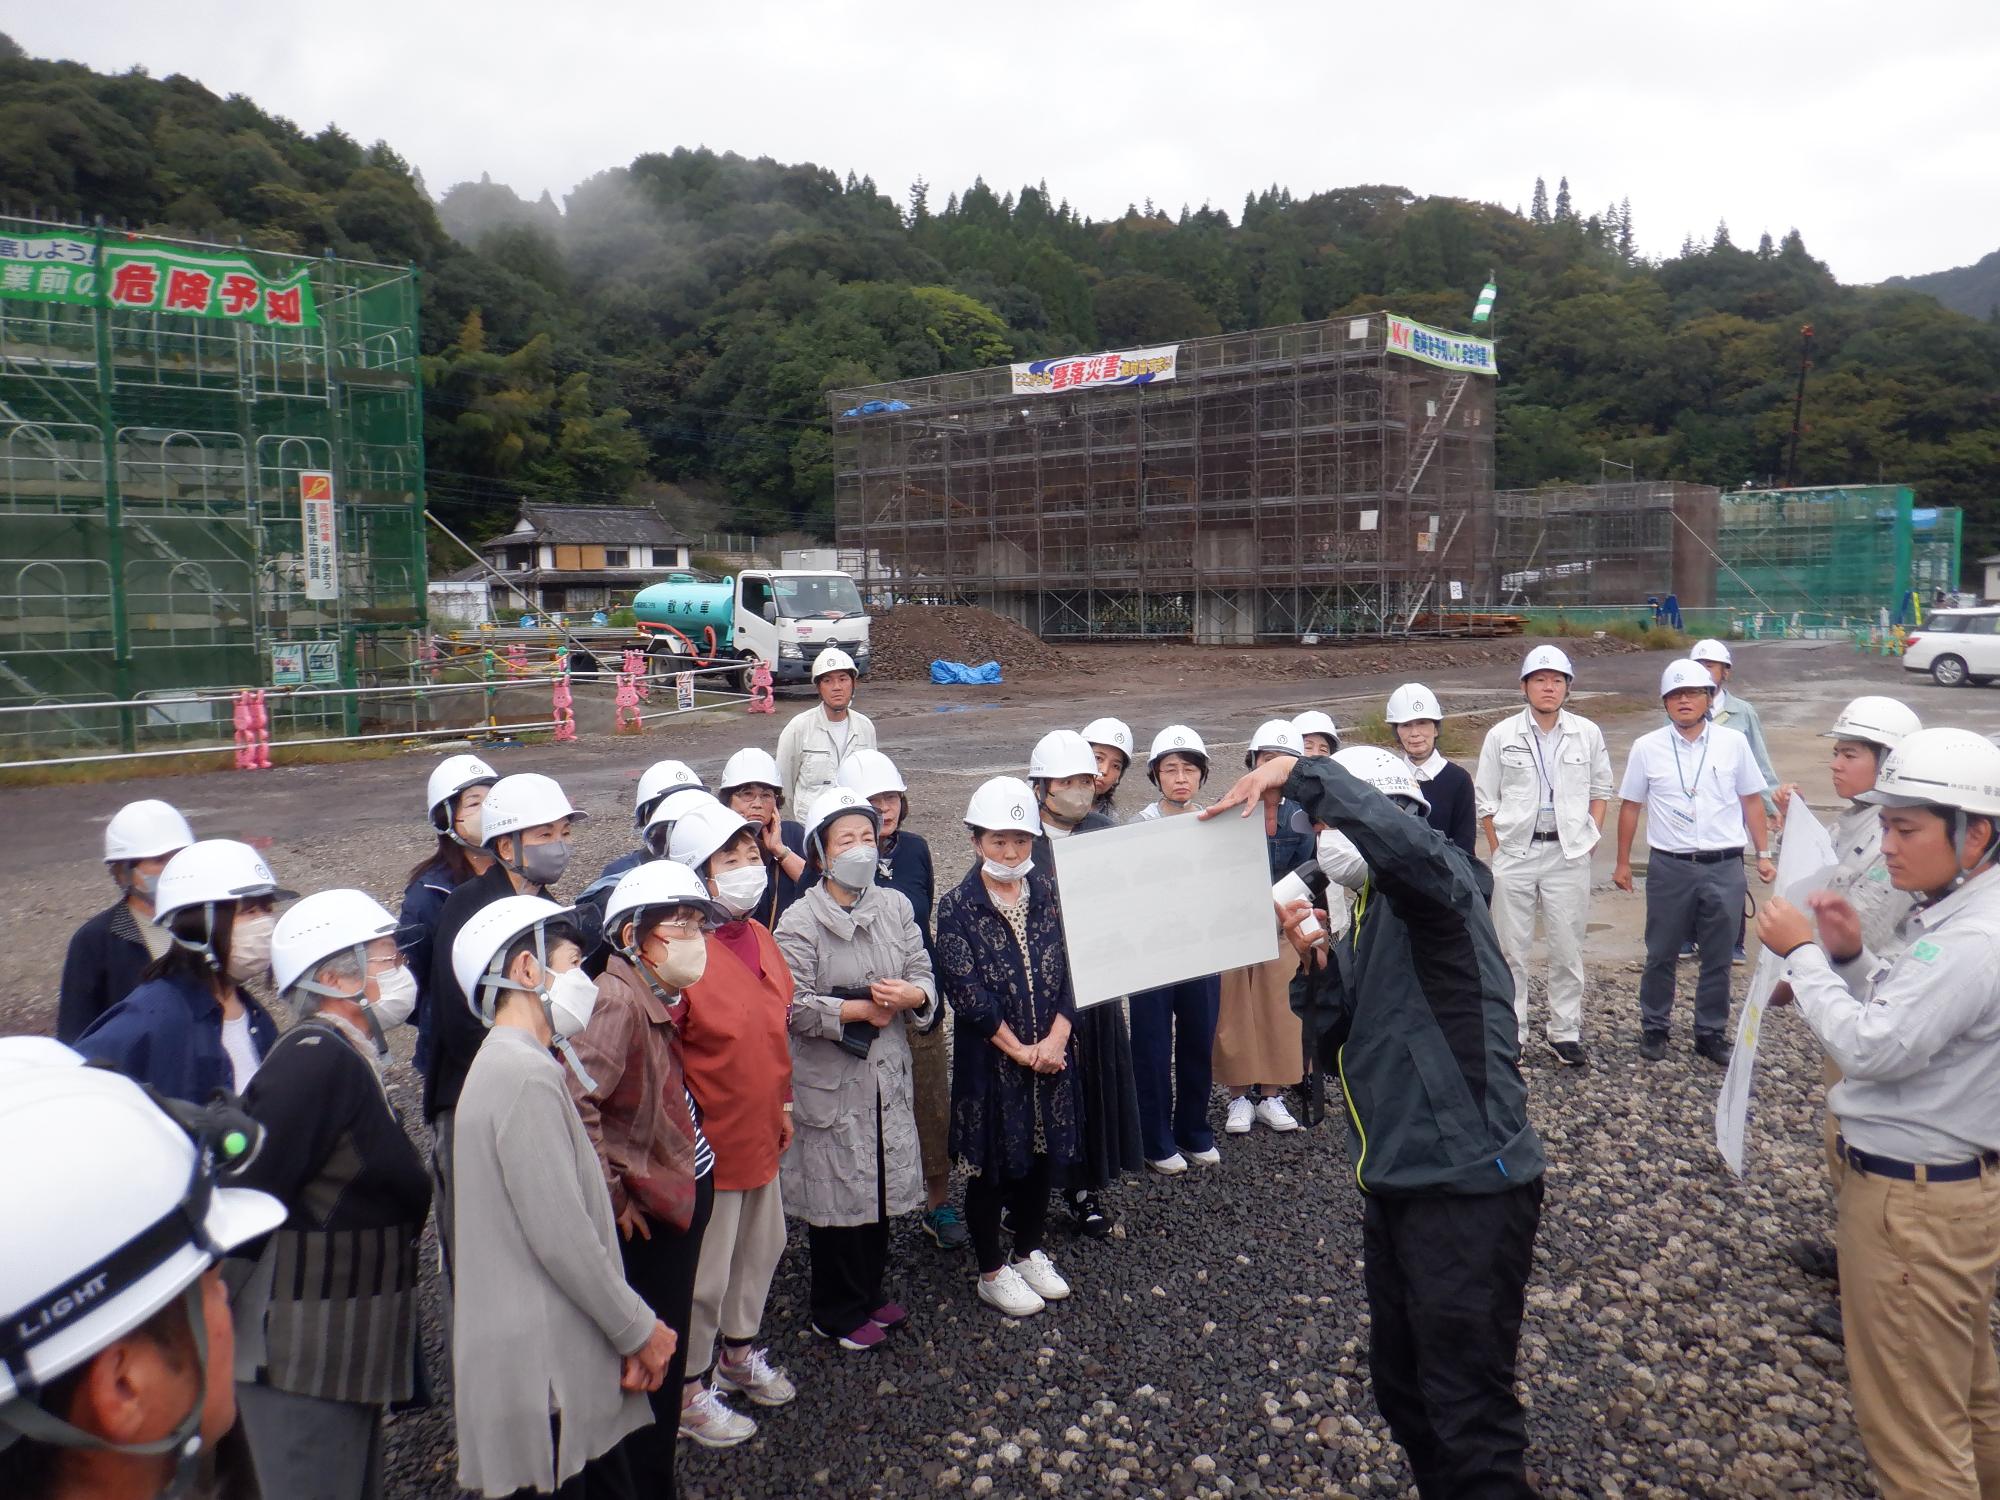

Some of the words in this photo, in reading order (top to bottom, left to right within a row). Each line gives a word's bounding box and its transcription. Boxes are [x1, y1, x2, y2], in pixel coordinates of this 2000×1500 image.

[111, 262, 303, 324] 危険予知
[1052, 355, 1121, 390] 墜落災害
[667, 600, 711, 615] 散水車
[18, 1272, 109, 1339] LIGHT
